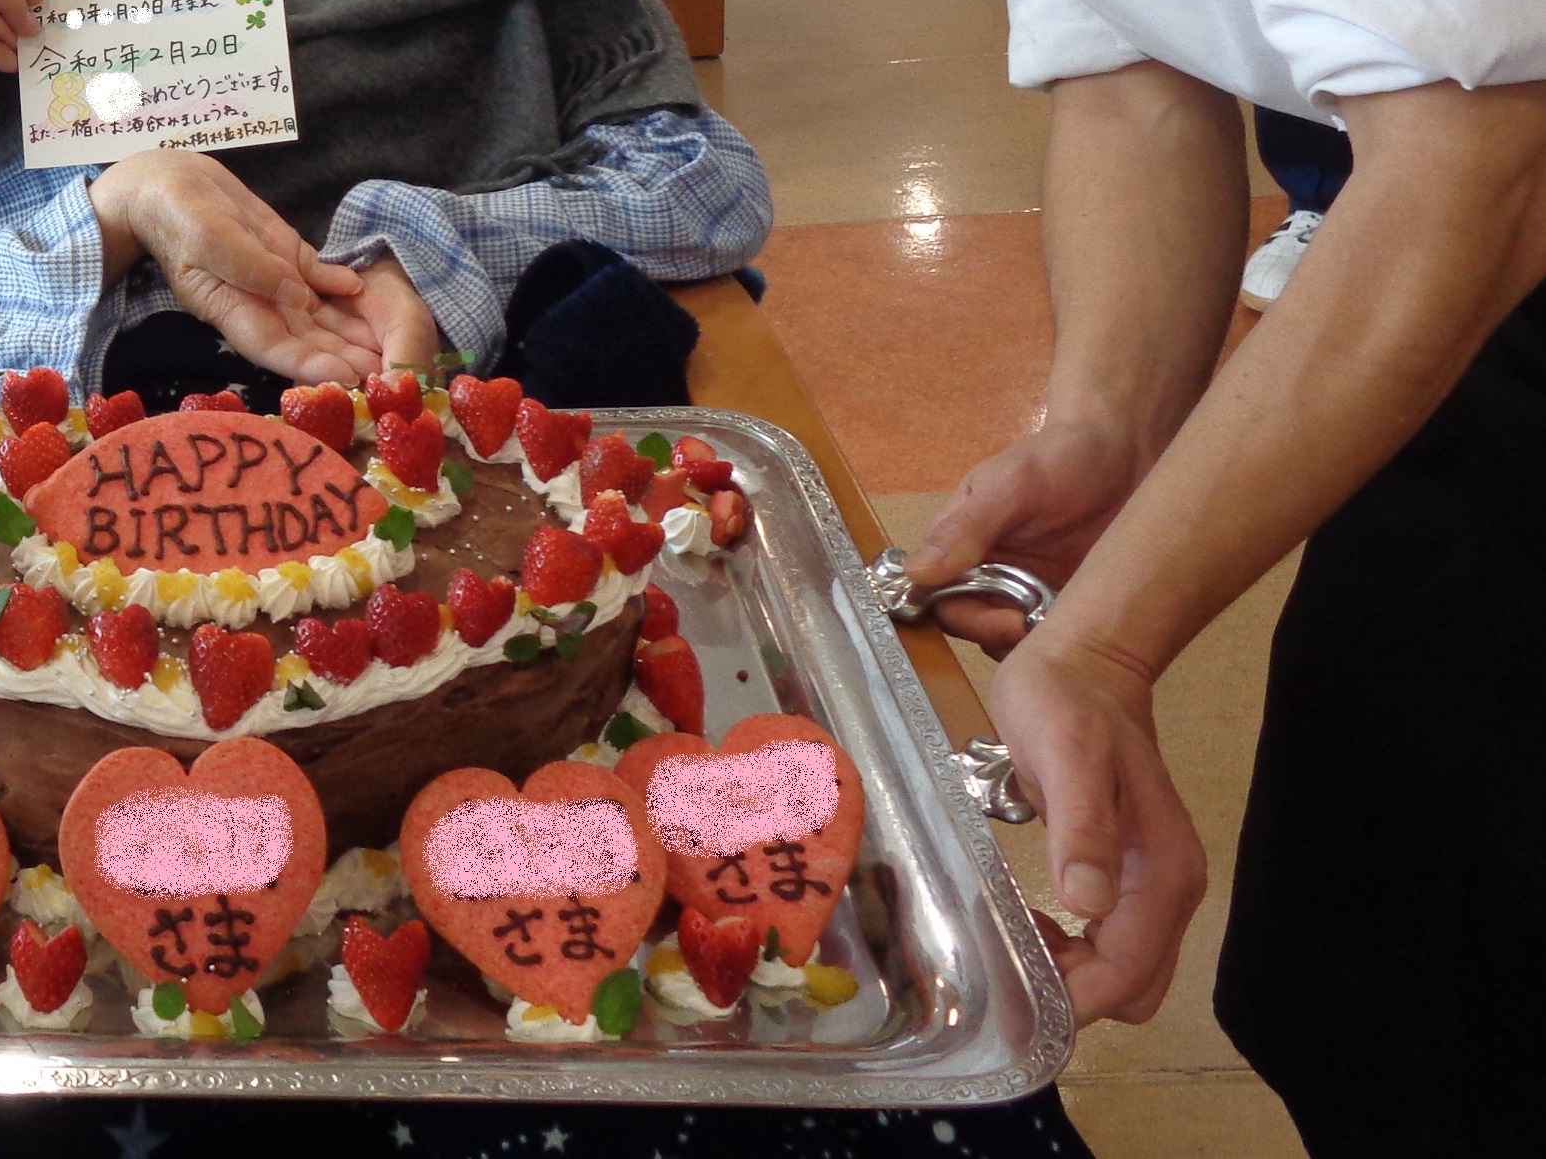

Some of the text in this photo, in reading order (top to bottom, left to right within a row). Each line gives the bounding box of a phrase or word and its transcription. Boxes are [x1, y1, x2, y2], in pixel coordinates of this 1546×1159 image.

[29, 34, 238, 80] 令和5年2月20日
[88, 433, 323, 502] HAPPY
[83, 478, 371, 560] BIRTHDAY
[706, 836, 832, 905] さま
[148, 892, 262, 980] さま
[492, 903, 616, 967] さま
